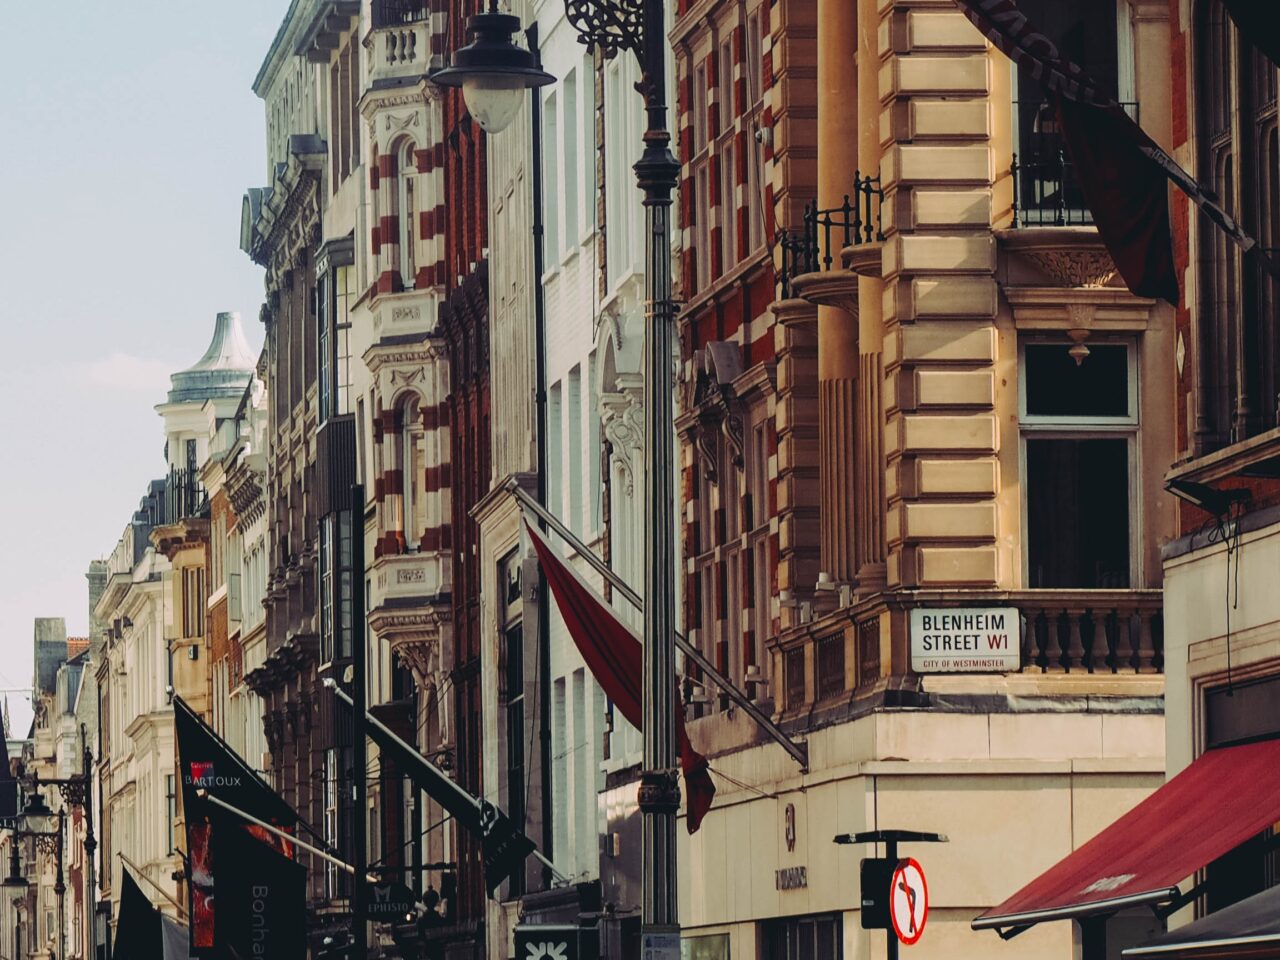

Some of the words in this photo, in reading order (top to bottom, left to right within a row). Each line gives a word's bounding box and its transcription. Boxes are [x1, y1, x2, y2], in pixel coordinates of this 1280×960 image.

[922, 614, 1005, 631] BLENHEIM
[922, 634, 981, 651] STREET
[987, 634, 1008, 650] W1
[923, 660, 939, 668] CITY
[941, 660, 951, 668] OF
[953, 659, 1004, 668] WESTMINSTER
